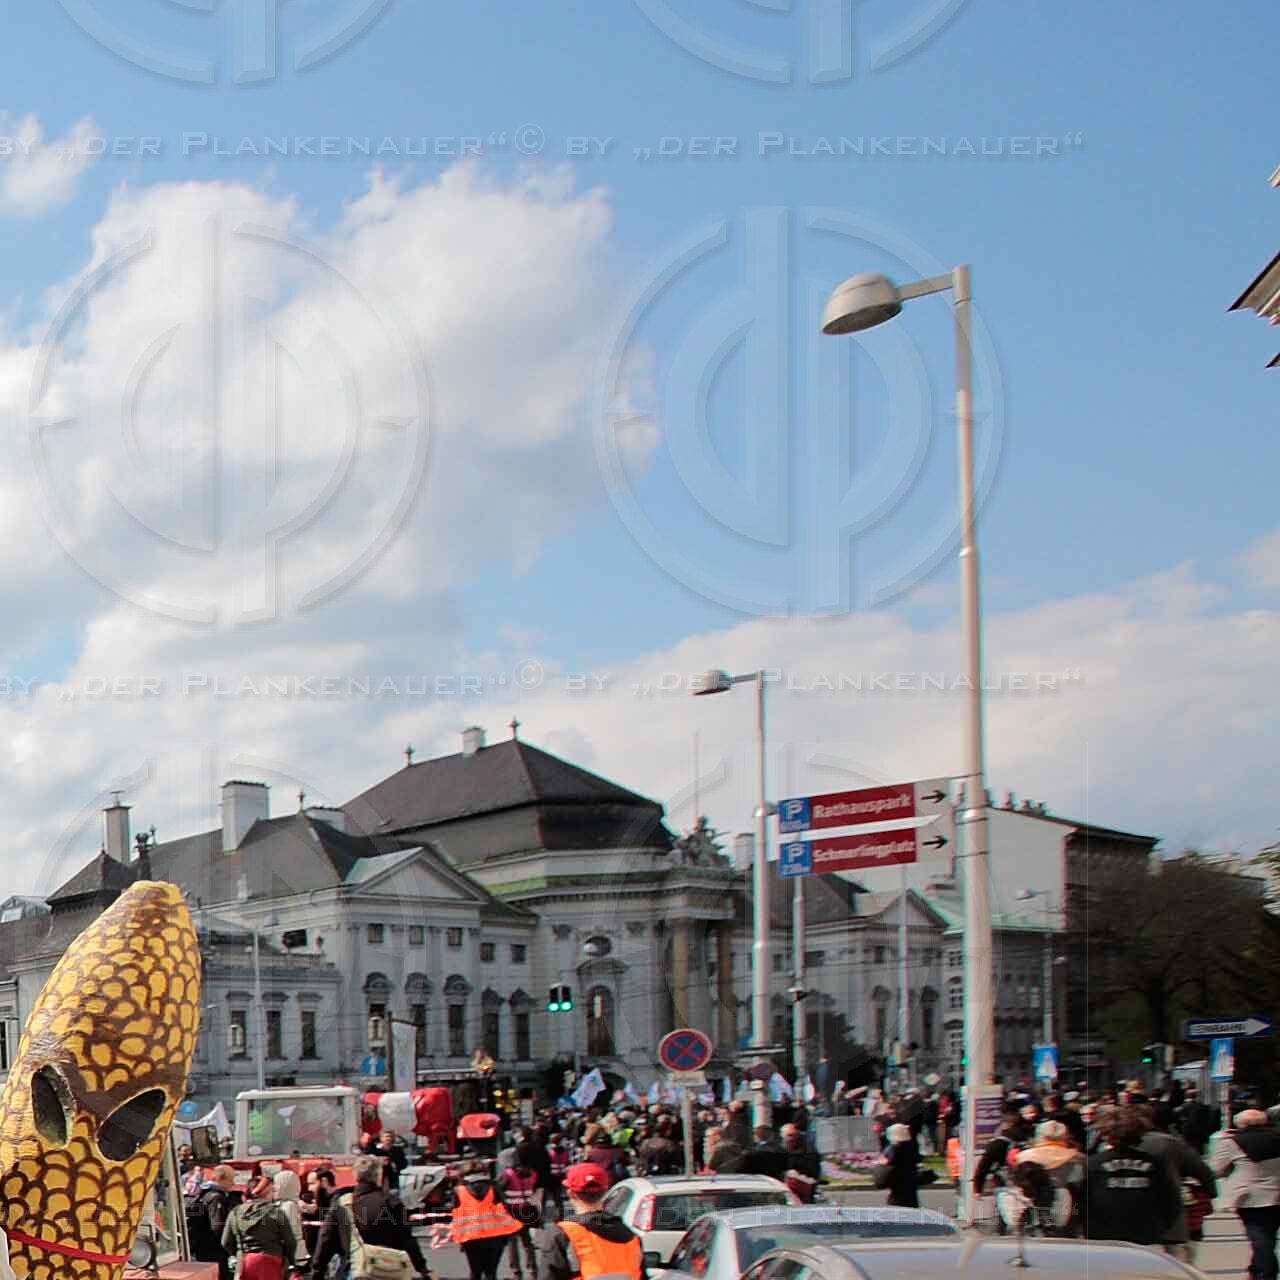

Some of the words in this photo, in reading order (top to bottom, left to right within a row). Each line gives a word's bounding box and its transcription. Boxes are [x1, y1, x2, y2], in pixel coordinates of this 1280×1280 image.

[784, 800, 803, 820] P
[813, 793, 912, 820] Rathauspark
[788, 843, 805, 864] P
[814, 840, 916, 863] Schmerlingplatz
